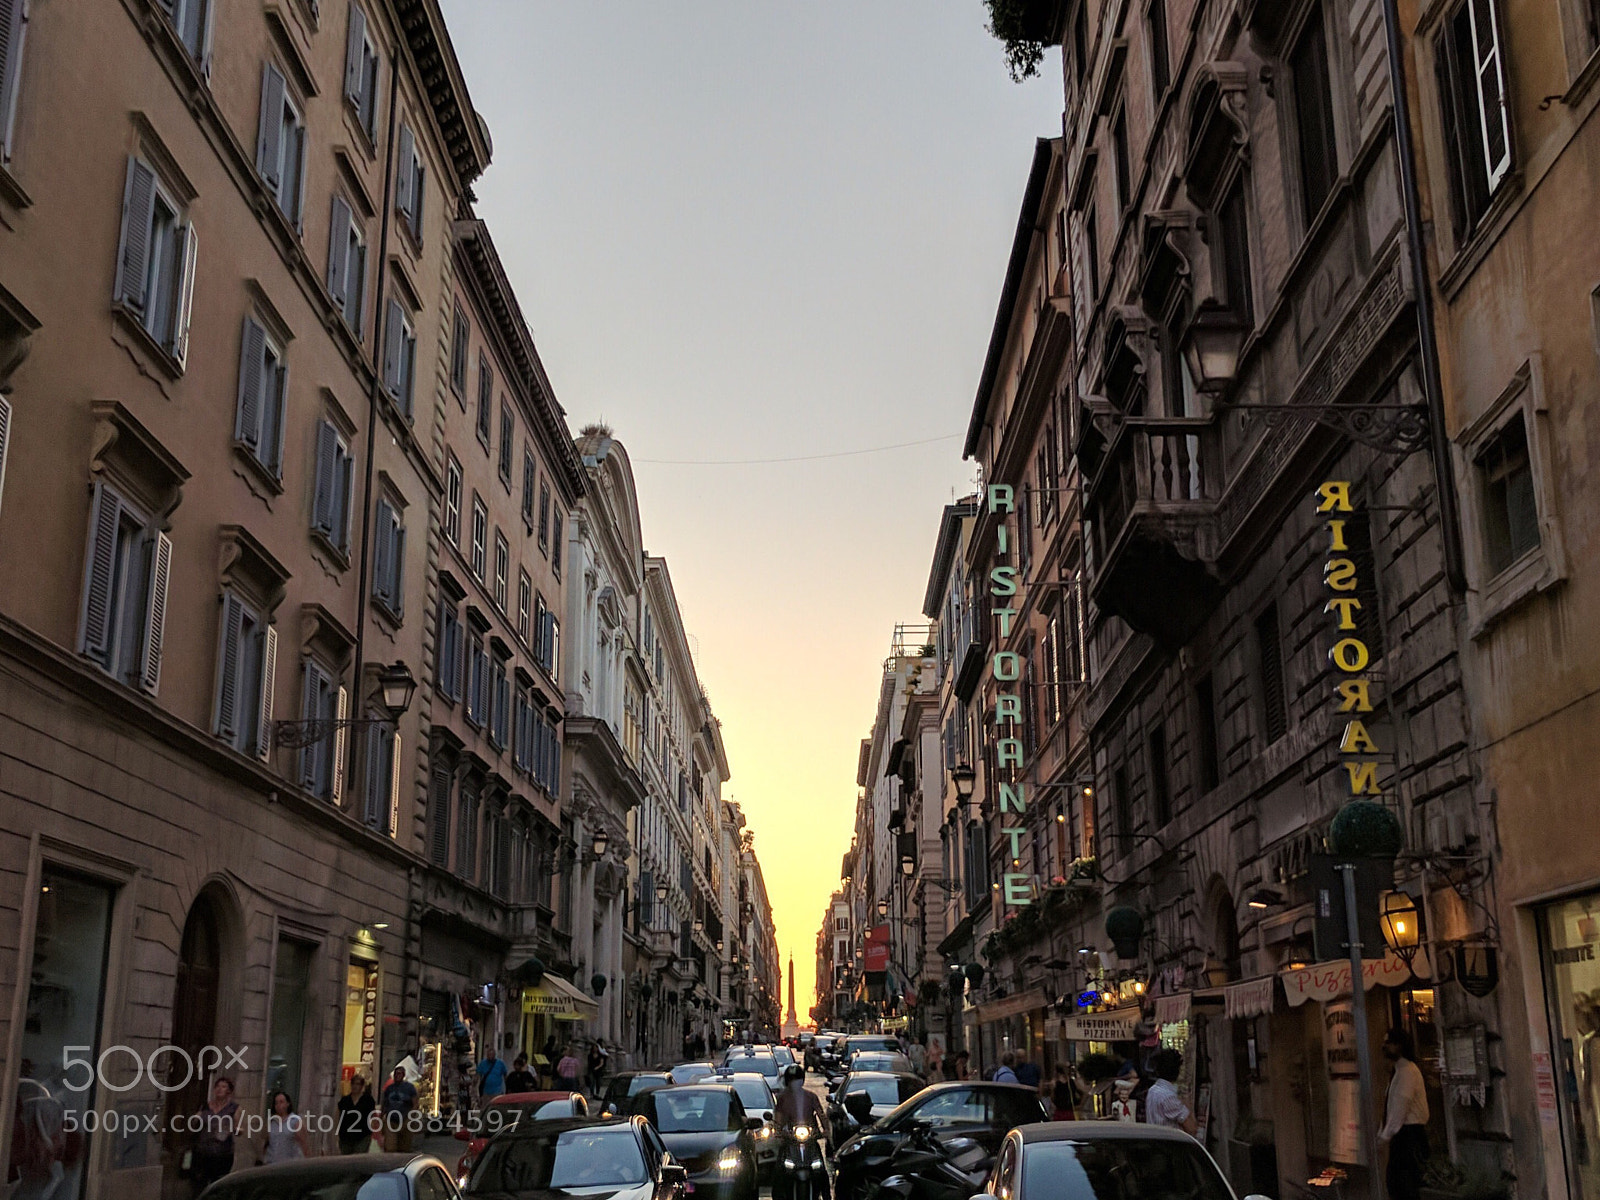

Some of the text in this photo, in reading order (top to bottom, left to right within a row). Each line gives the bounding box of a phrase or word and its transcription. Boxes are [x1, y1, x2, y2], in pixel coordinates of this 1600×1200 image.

[988, 483, 1032, 906] RISTORANTE
[1296, 956, 1416, 993] Pizzria
[531, 1005, 566, 1013] PIZZERIA
[1076, 1018, 1133, 1029] RISTORANTE
[1084, 1029, 1126, 1039] PIZZERIA
